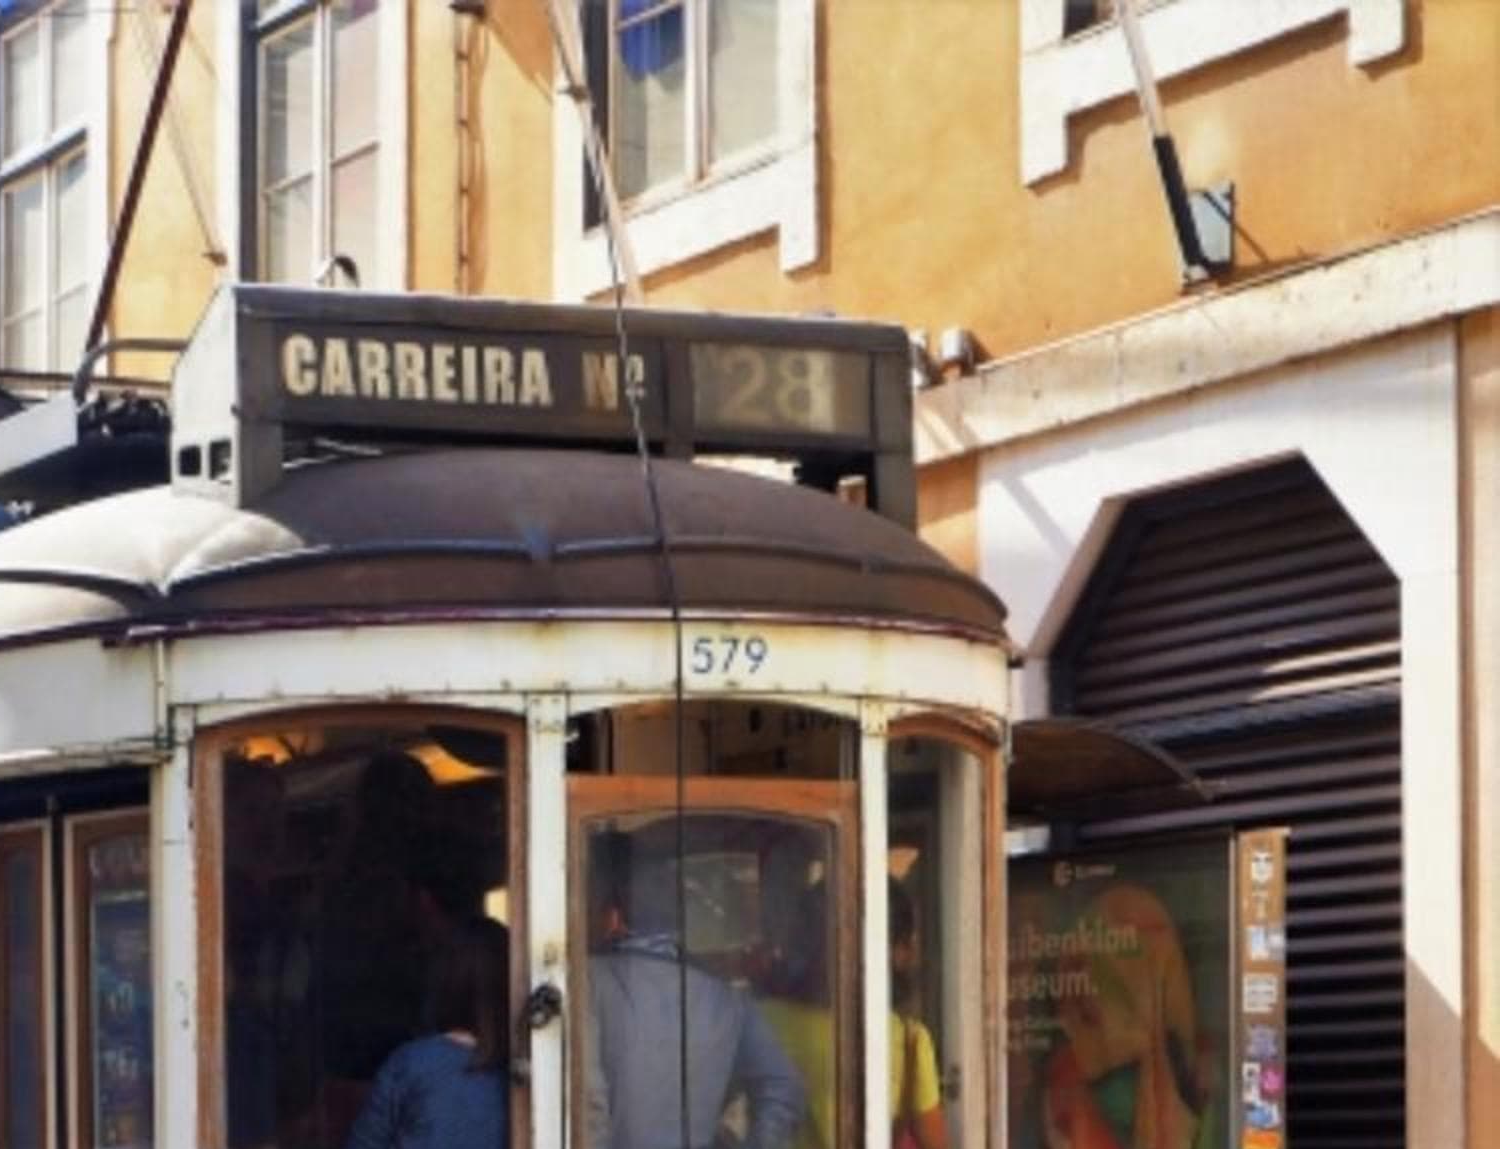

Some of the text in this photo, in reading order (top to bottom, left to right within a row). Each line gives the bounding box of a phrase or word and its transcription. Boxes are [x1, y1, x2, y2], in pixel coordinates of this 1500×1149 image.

[281, 333, 554, 408] CARREIRA
[718, 347, 819, 427] 28
[692, 637, 768, 674] 579
